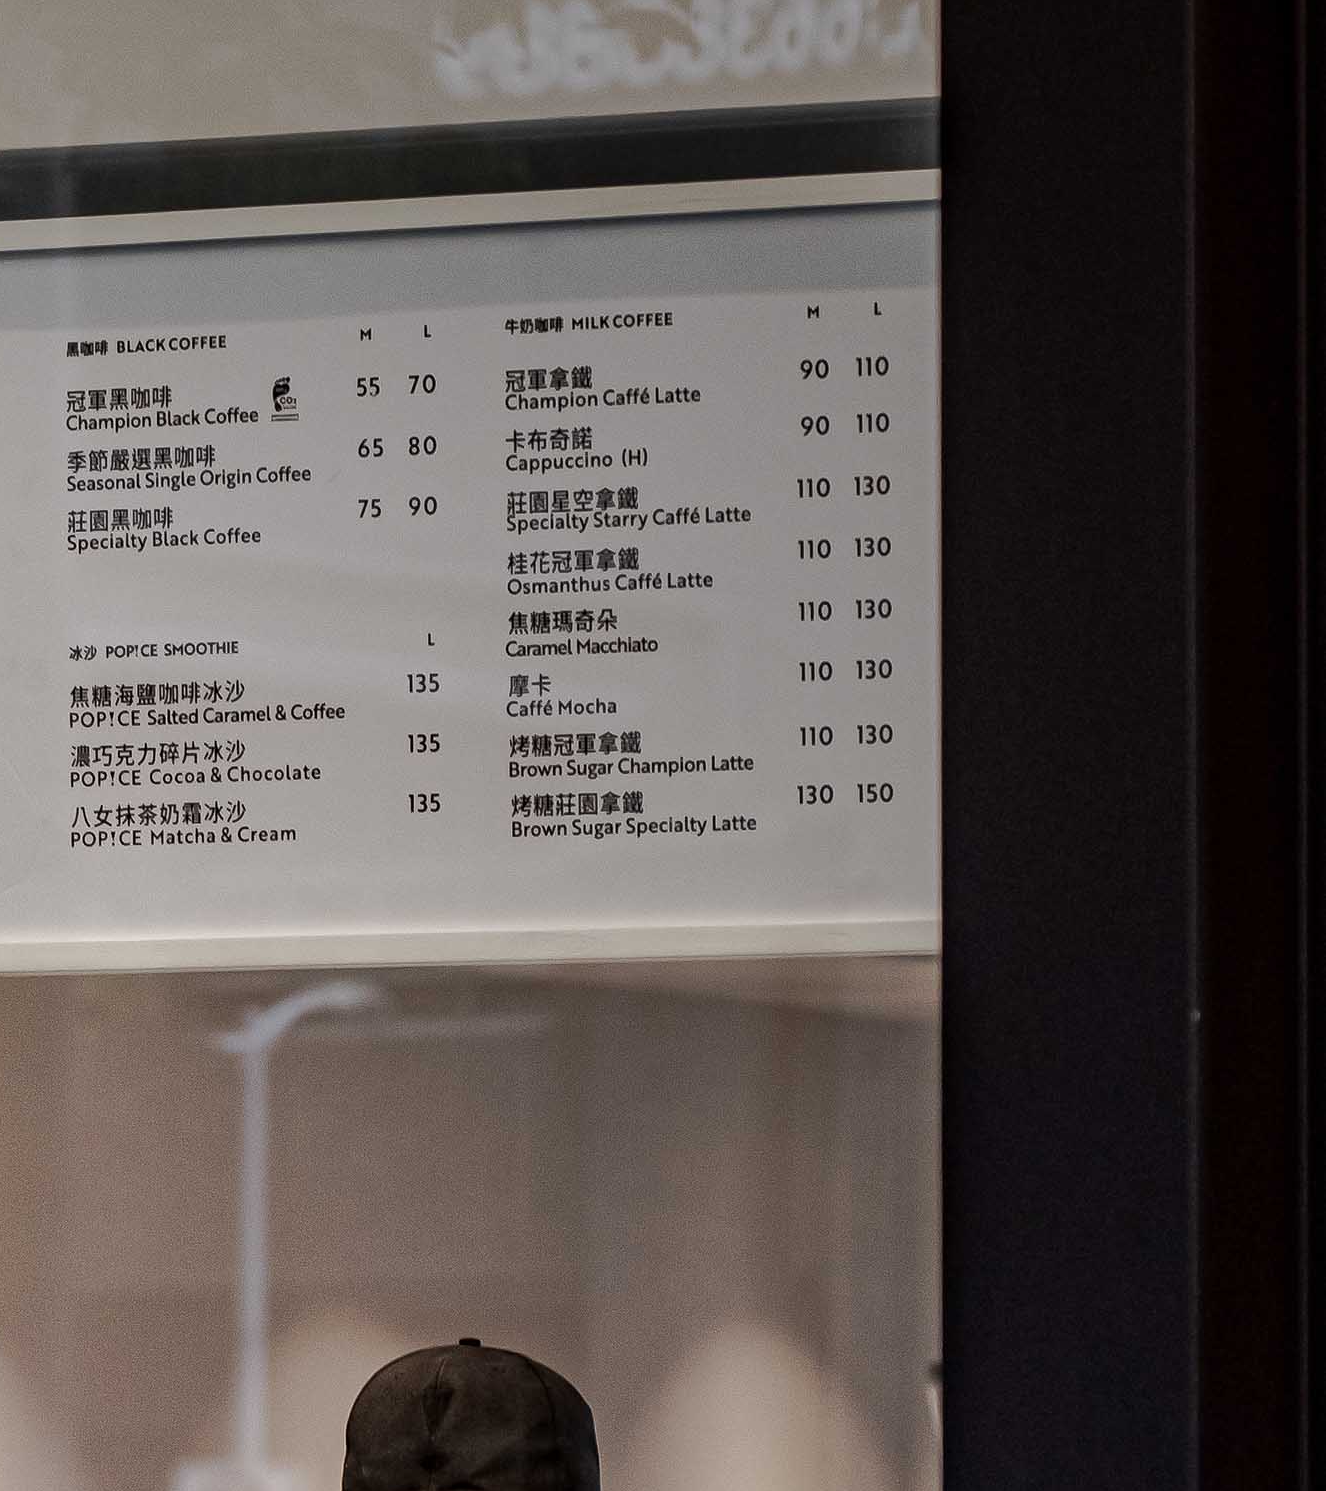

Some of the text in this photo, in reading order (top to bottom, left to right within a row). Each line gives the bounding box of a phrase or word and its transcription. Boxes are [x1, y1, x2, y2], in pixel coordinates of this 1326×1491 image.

[572, 313, 672, 330] MILK COFFEE
[117, 325, 431, 353] BLACK COFFEE L
[506, 356, 889, 392] 冠軍拿鐵 90 110
[67, 375, 436, 412] 冠軍黑咖啡 55 70
[505, 392, 597, 412] Champion
[656, 387, 700, 403] Latte
[67, 407, 258, 433] Champion Black Coffee
[506, 413, 889, 453] 卡布奇諾 90 110
[68, 436, 436, 473] 季節嚴選黑咖啡 65 80
[506, 448, 647, 474] Cappuccino (H)
[68, 466, 310, 491] Seasonal Single Origin Coffee
[507, 475, 890, 515] 莊園星空拿鐵 110 130
[68, 497, 437, 533] 莊園黑咖啡 75 90
[507, 513, 589, 535] Specialty
[594, 512, 648, 530] Starry
[706, 507, 751, 523] Latte
[68, 528, 260, 554] Specialty Black Coffee
[508, 537, 891, 574] 桂花冠軍拿鐵 110 130
[508, 576, 610, 595] Osmanthus
[668, 573, 713, 588] Latte
[509, 599, 892, 635] 焦糖瑪奇朵 110 130
[106, 641, 238, 658] POP!CE SMOOTHIE
[506, 637, 658, 657] Caramel Macchiato
[71, 674, 439, 708] 焦糖海鹽咖啡冰沙 135
[509, 659, 892, 697] 摩卡 110 130
[70, 703, 345, 728] POP!CE Salted Caramel Coffee
[559, 698, 616, 715] Mocha
[800, 726, 833, 746] 110
[857, 724, 893, 744] 130
[71, 734, 440, 768] 濃巧克力碎片冰沙 135
[71, 765, 320, 787] POP!CE Cocoa Chocolate
[509, 756, 753, 779] Brown Sugar Champion Latte
[797, 785, 833, 804] 130
[857, 783, 893, 803] 150
[72, 794, 440, 827] 八女抹茶奶霜冰沙 135
[71, 826, 296, 847] POP!CE Matcha Cream
[512, 815, 756, 839] Brown Sugar Specialty Latte
